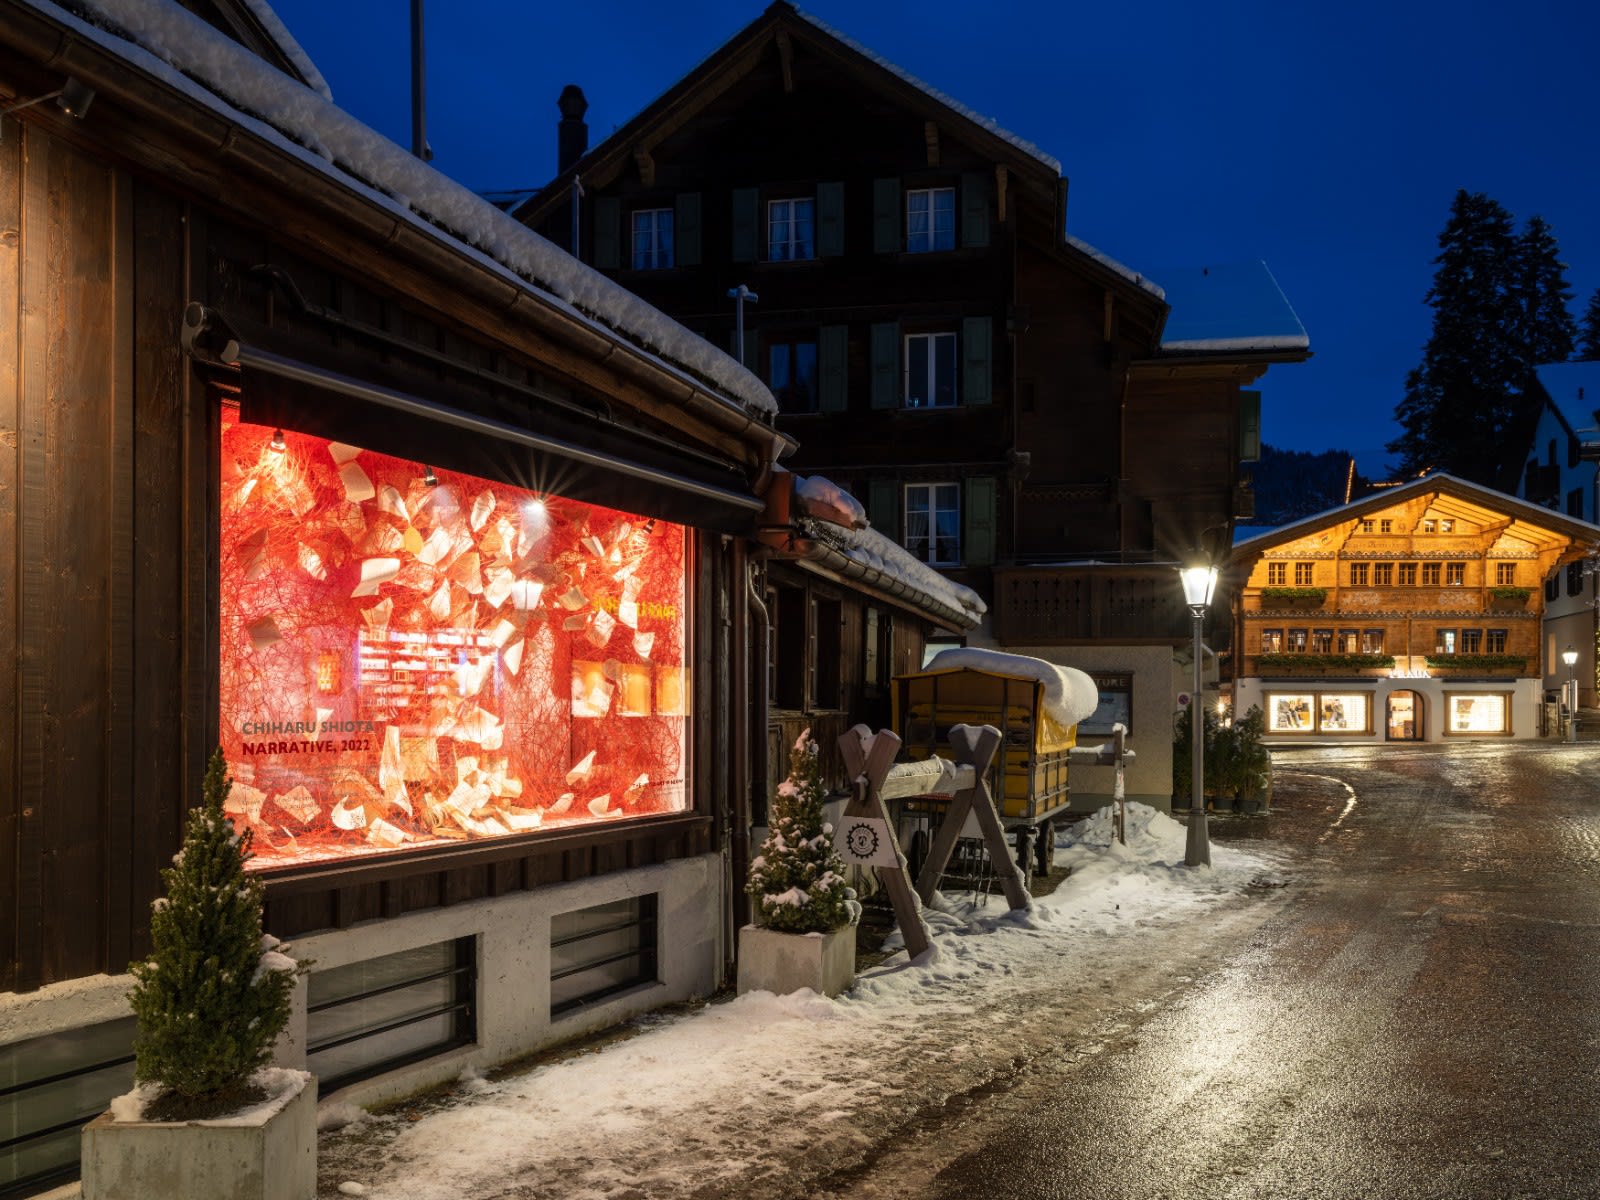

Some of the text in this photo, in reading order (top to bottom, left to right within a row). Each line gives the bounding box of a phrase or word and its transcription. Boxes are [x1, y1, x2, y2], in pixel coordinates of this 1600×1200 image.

[242, 720, 375, 735] CHIHARU SHIOTA
[242, 739, 370, 756] NARRATIVE, 2022
